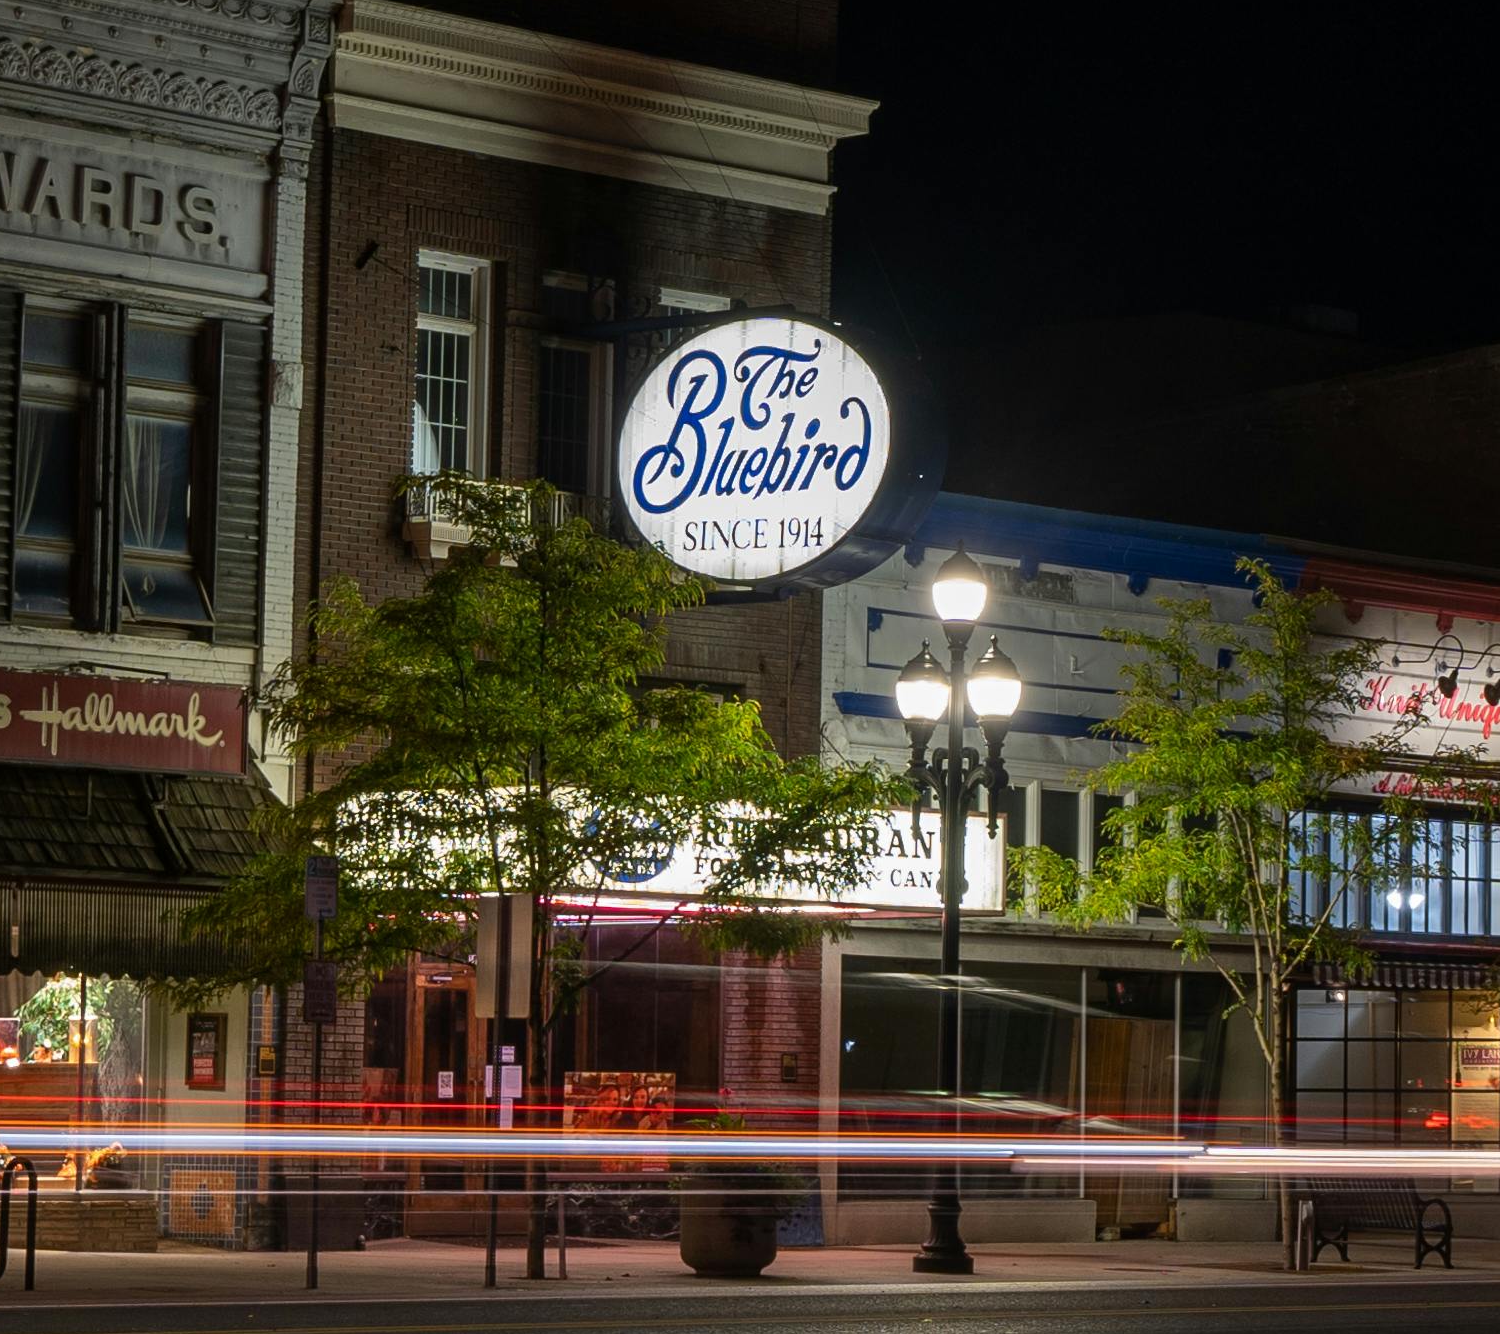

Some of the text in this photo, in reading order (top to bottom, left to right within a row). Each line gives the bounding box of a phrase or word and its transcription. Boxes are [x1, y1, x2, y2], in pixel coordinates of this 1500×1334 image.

[734, 339, 821, 430] The
[633, 349, 871, 514] Bluebird
[683, 517, 824, 551] SINCE 1914
[19, 680, 225, 756] Hallmark
[1463, 1049, 1479, 1060] IVY
